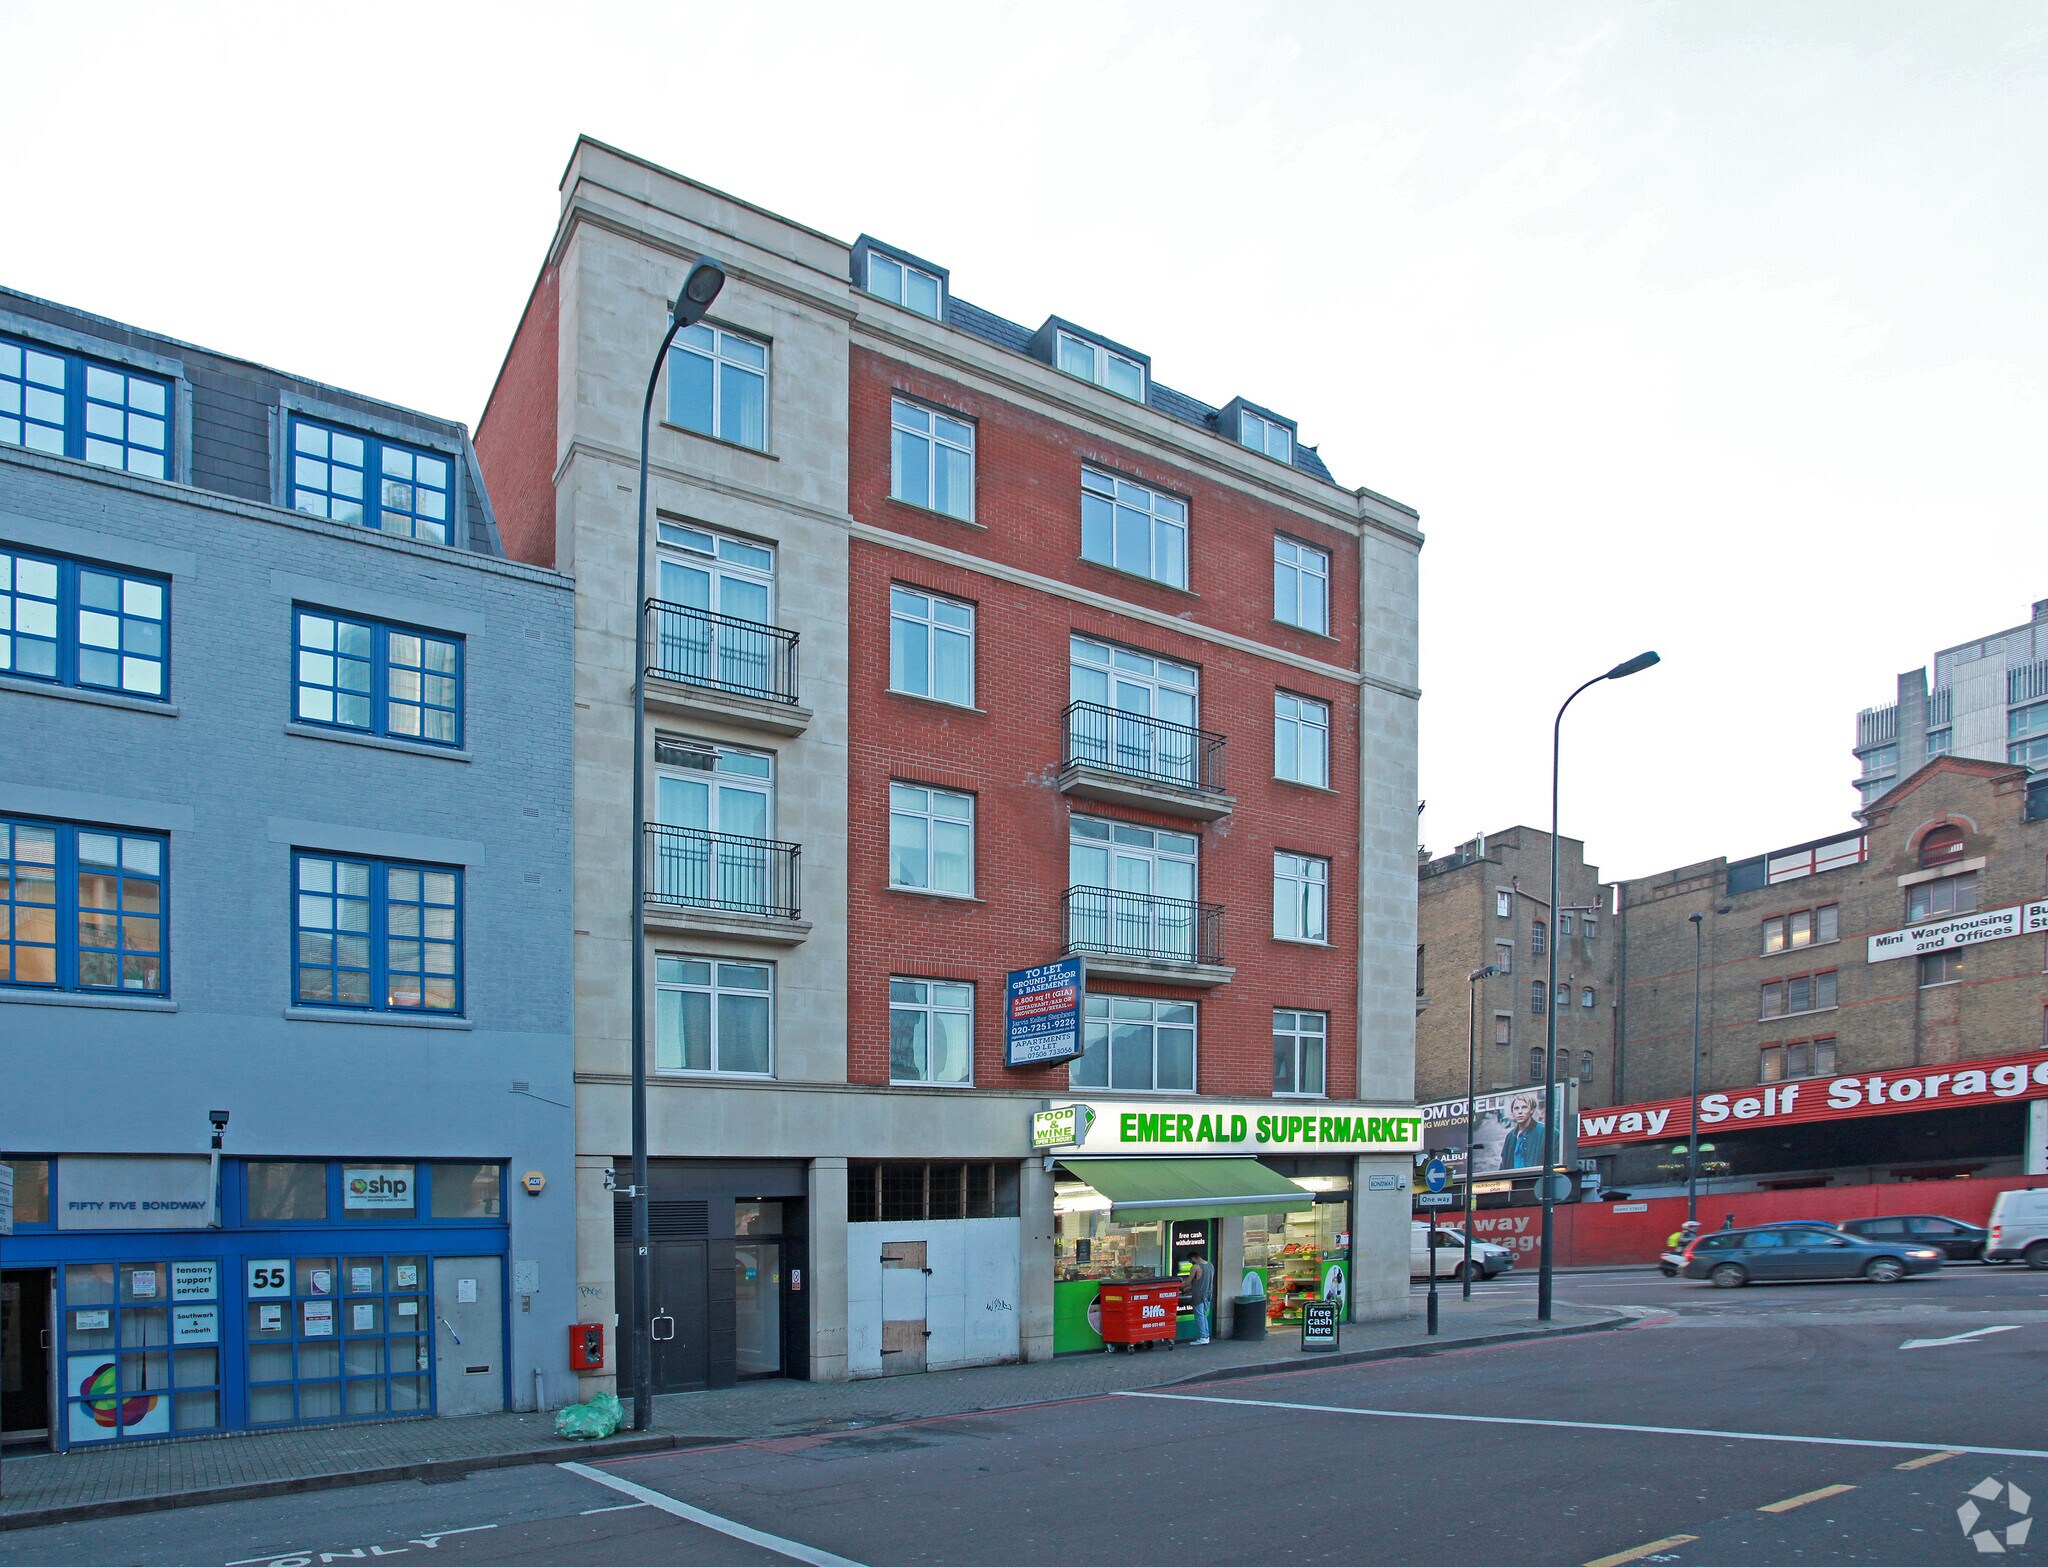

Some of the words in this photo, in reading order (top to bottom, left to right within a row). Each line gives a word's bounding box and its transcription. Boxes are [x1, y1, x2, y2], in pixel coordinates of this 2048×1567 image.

[1876, 934, 1903, 947] Mini
[1911, 913, 2013, 940] Warehousing
[1916, 937, 1944, 951] and
[1954, 926, 2012, 943] Offices
[1026, 968, 1040, 979] TO
[1044, 964, 1062, 976] LET
[1012, 976, 1046, 989] GROUND
[1048, 970, 1076, 982] FLOOR
[1026, 979, 1070, 994] BASEMENT
[1035, 994, 1044, 1002] sq
[1052, 989, 1072, 998] (GIA)
[1048, 1010, 1076, 1021] Stephens
[1012, 1017, 1076, 1035] 020-7251-9226
[1016, 1033, 1071, 1048] APARTMENTS
[1042, 1042, 1058, 1050] LET
[1700, 1085, 1799, 1123] Self
[1036, 1110, 1074, 1122] FOOD
[1422, 1105, 1446, 1120] OM
[1050, 1120, 1058, 1128] &
[1120, 1113, 1248, 1143] EMERALD
[1256, 1115, 1422, 1143] SUPERMARKET
[1433, 1119, 1450, 1128] WAY
[1036, 1126, 1072, 1138] WINE
[368, 1174, 407, 1198] shp
[68, 1202, 104, 1210] FIFTY
[109, 1202, 136, 1210] FIVE
[142, 1201, 206, 1210] BONDWAY
[1176, 1238, 1206, 1246] withdrawals
[176, 1266, 213, 1276] tenancy
[176, 1276, 212, 1285] support
[253, 1268, 285, 1288] 55
[176, 1286, 210, 1294] service
[177, 1312, 214, 1320] Southwark
[1142, 1304, 1166, 1318] Biffa
[1310, 1308, 1331, 1317] free
[1308, 1316, 1332, 1326] cash
[1308, 1326, 1332, 1334] here
[268, 1536, 442, 1567] ONLY
